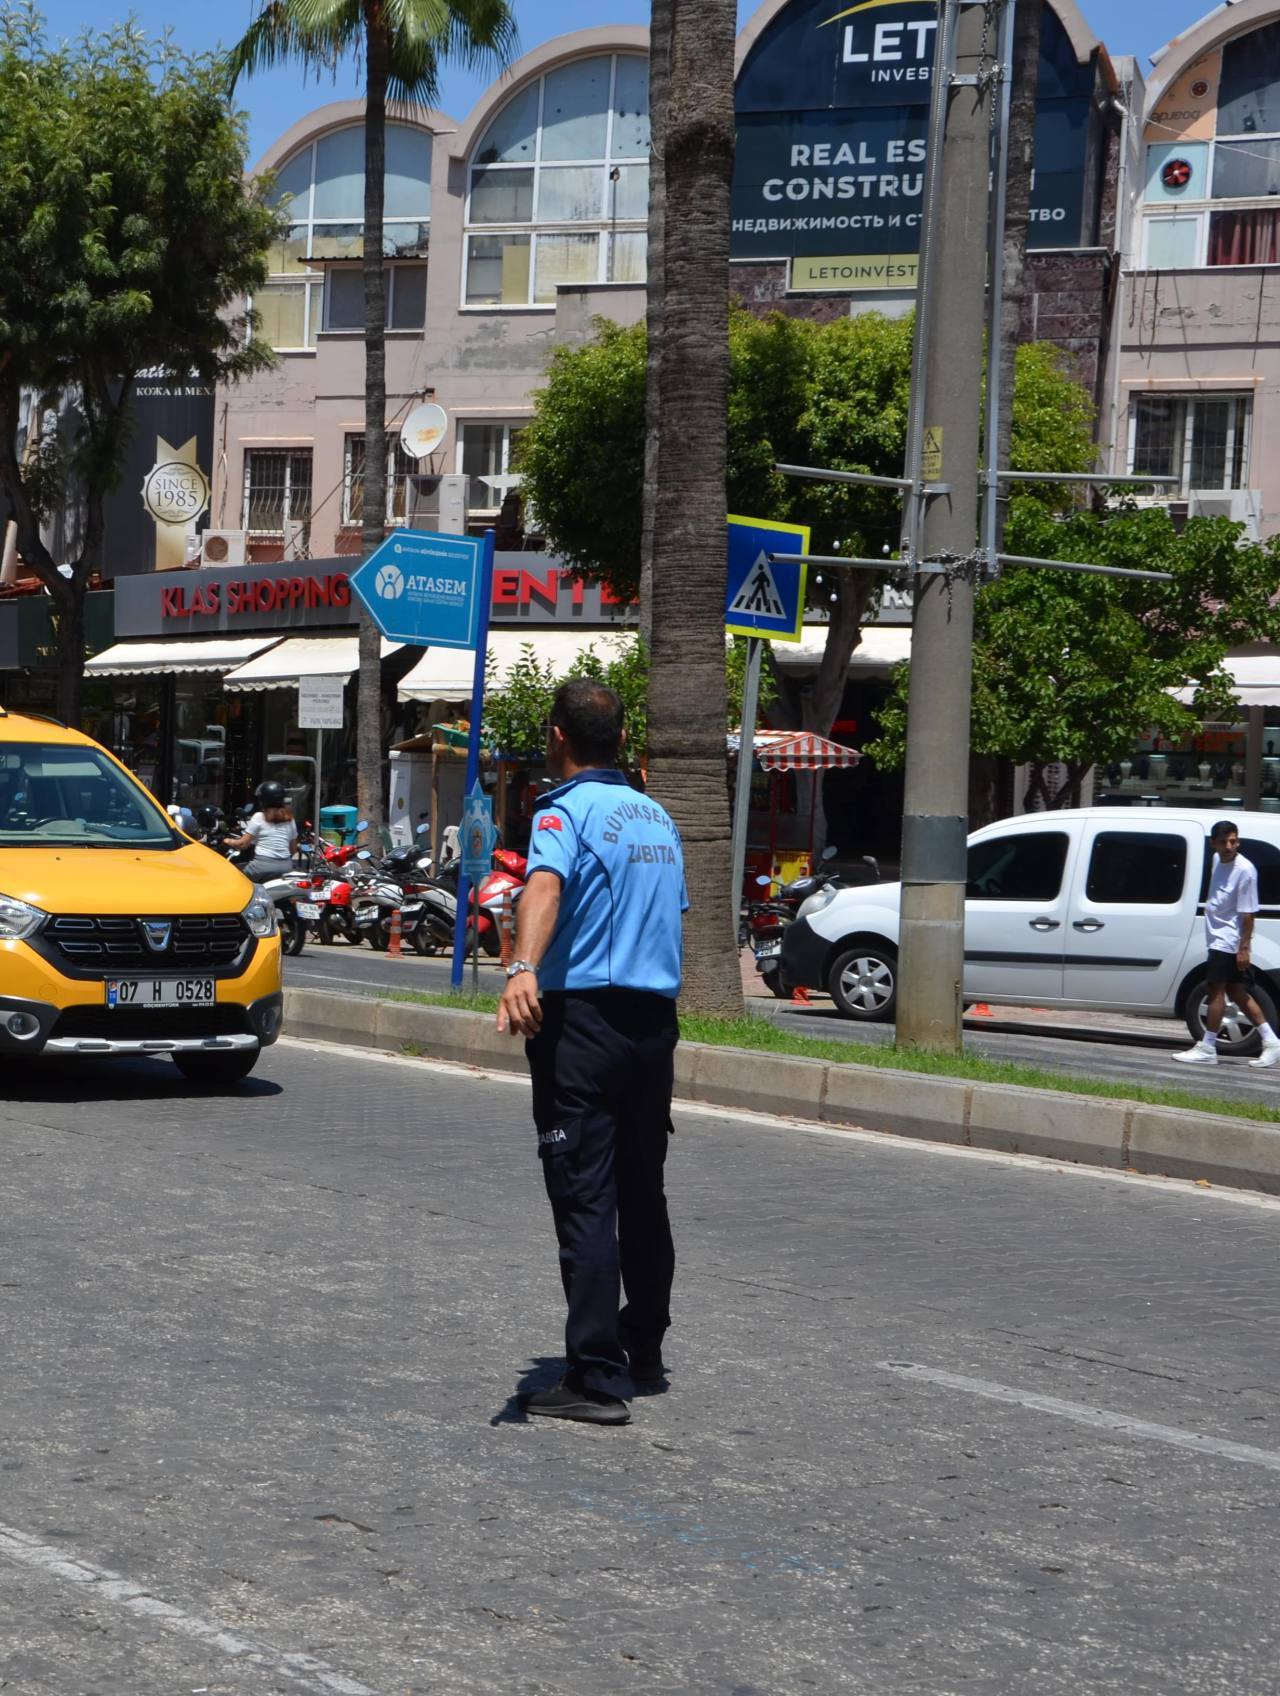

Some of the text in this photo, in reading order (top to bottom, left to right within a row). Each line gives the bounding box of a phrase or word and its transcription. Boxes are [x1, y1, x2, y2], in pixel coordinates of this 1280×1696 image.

[842, 20, 939, 63] LET
[790, 139, 927, 167] REAL ES
[762, 173, 924, 201] CONSTRU
[732, 215, 883, 234] НЕДВИЖИМОСТЬ
[888, 215, 900, 228] И
[136, 386, 171, 396] КОЖА
[185, 386, 216, 396] МЕХ
[155, 478, 198, 490] SINCE
[156, 491, 198, 507] 1985
[160, 582, 220, 618] KLAS
[226, 572, 352, 614] SHOPPING
[492, 569, 641, 604] ENTE
[406, 575, 467, 596] ATASEM
[603, 801, 681, 848] BÜYÜKŞEH
[627, 844, 676, 865] ZABITA
[120, 980, 213, 1001] 07 H 0528
